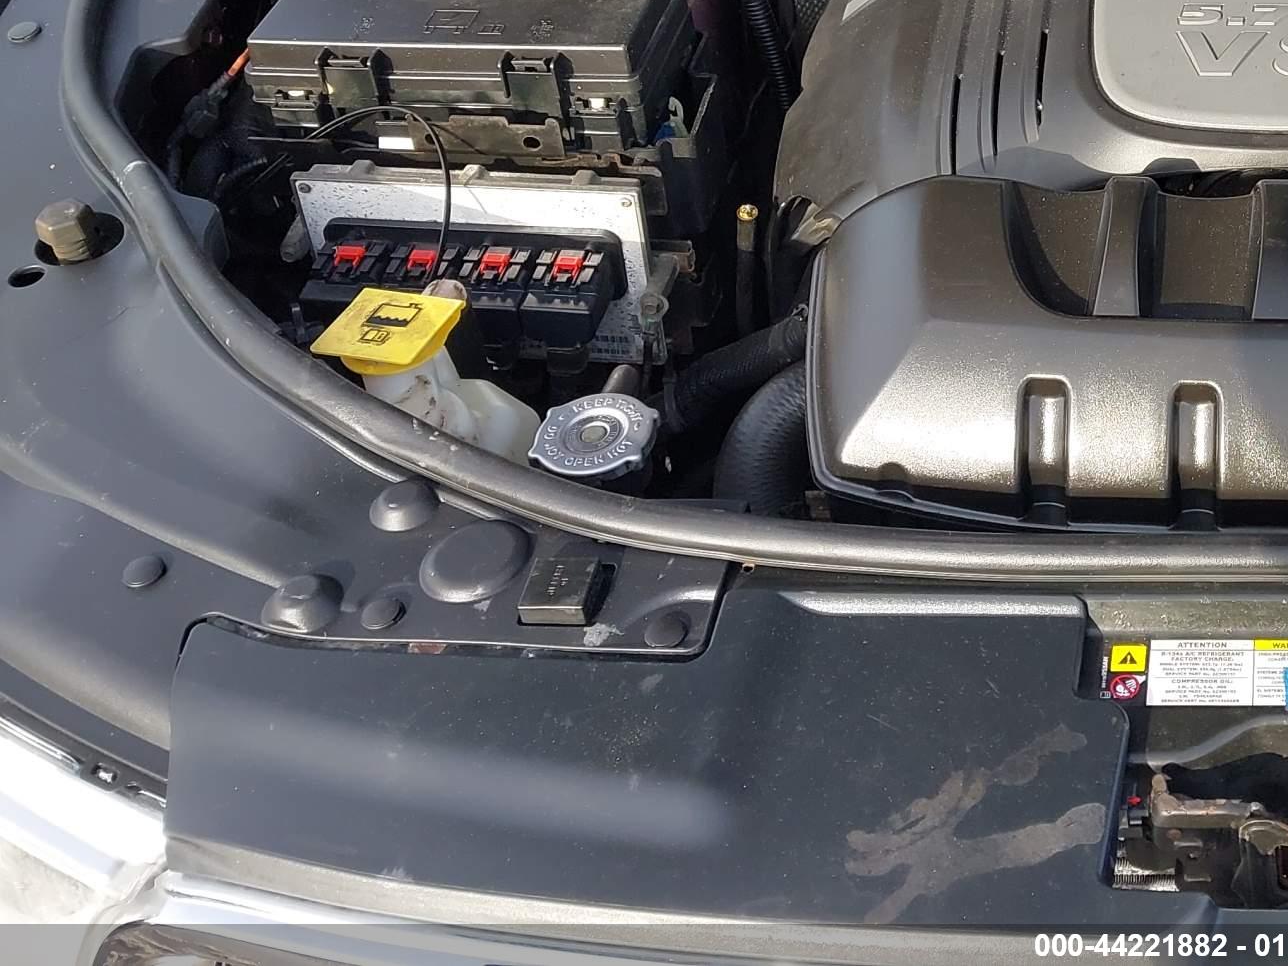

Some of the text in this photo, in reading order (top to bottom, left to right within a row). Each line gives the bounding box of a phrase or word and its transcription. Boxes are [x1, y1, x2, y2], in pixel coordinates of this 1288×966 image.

[572, 397, 643, 422] KEEP TIGHT
[543, 443, 565, 460] NOT
[564, 455, 605, 467] OPEN
[607, 439, 633, 459] HOT
